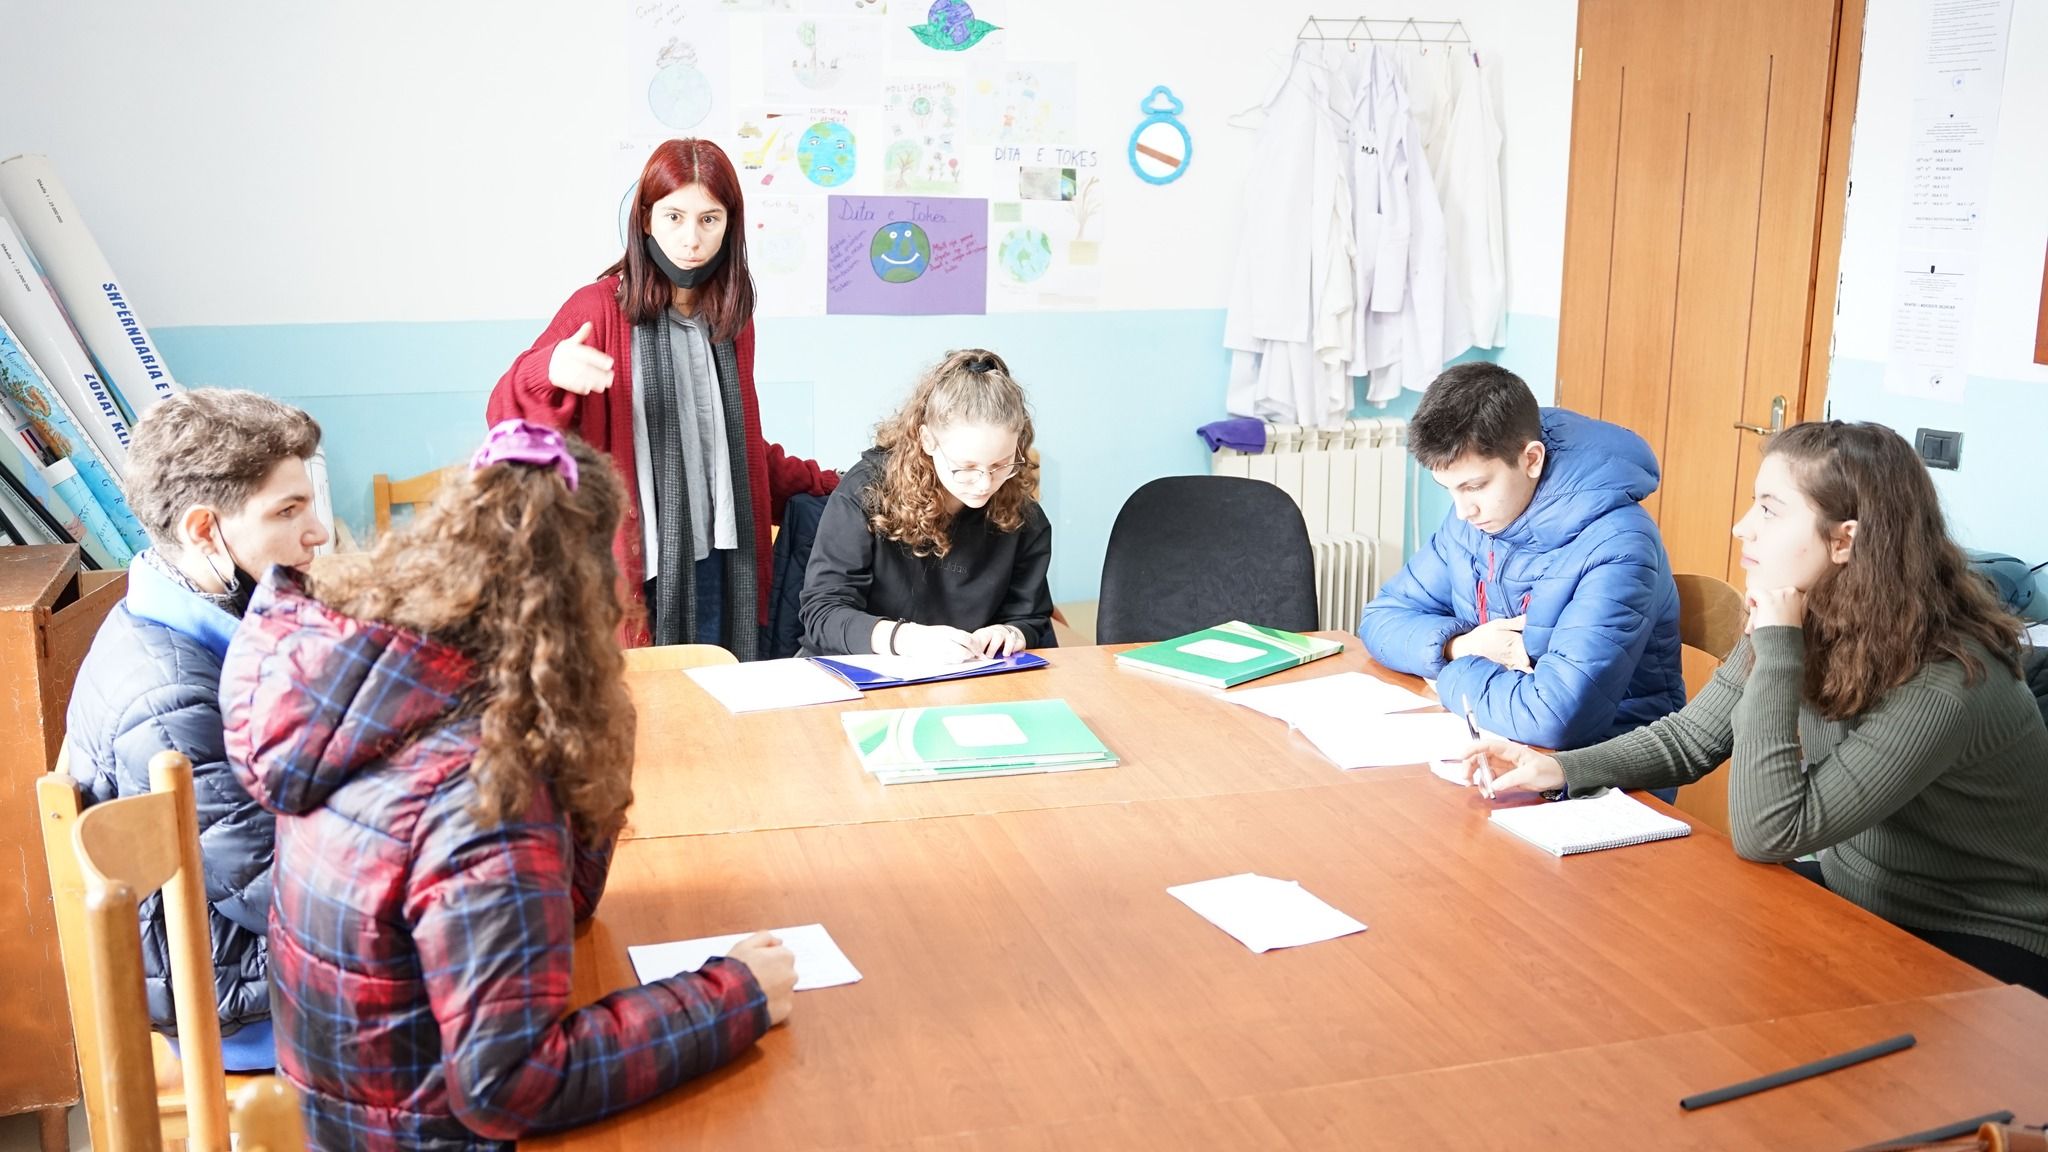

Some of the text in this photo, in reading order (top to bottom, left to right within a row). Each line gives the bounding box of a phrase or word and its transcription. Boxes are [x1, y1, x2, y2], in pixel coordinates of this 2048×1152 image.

[995, 146, 1021, 161] DITA
[1056, 148, 1097, 168] TOKES
[840, 198, 875, 221] Dita
[84, 373, 118, 418] ZONAT
